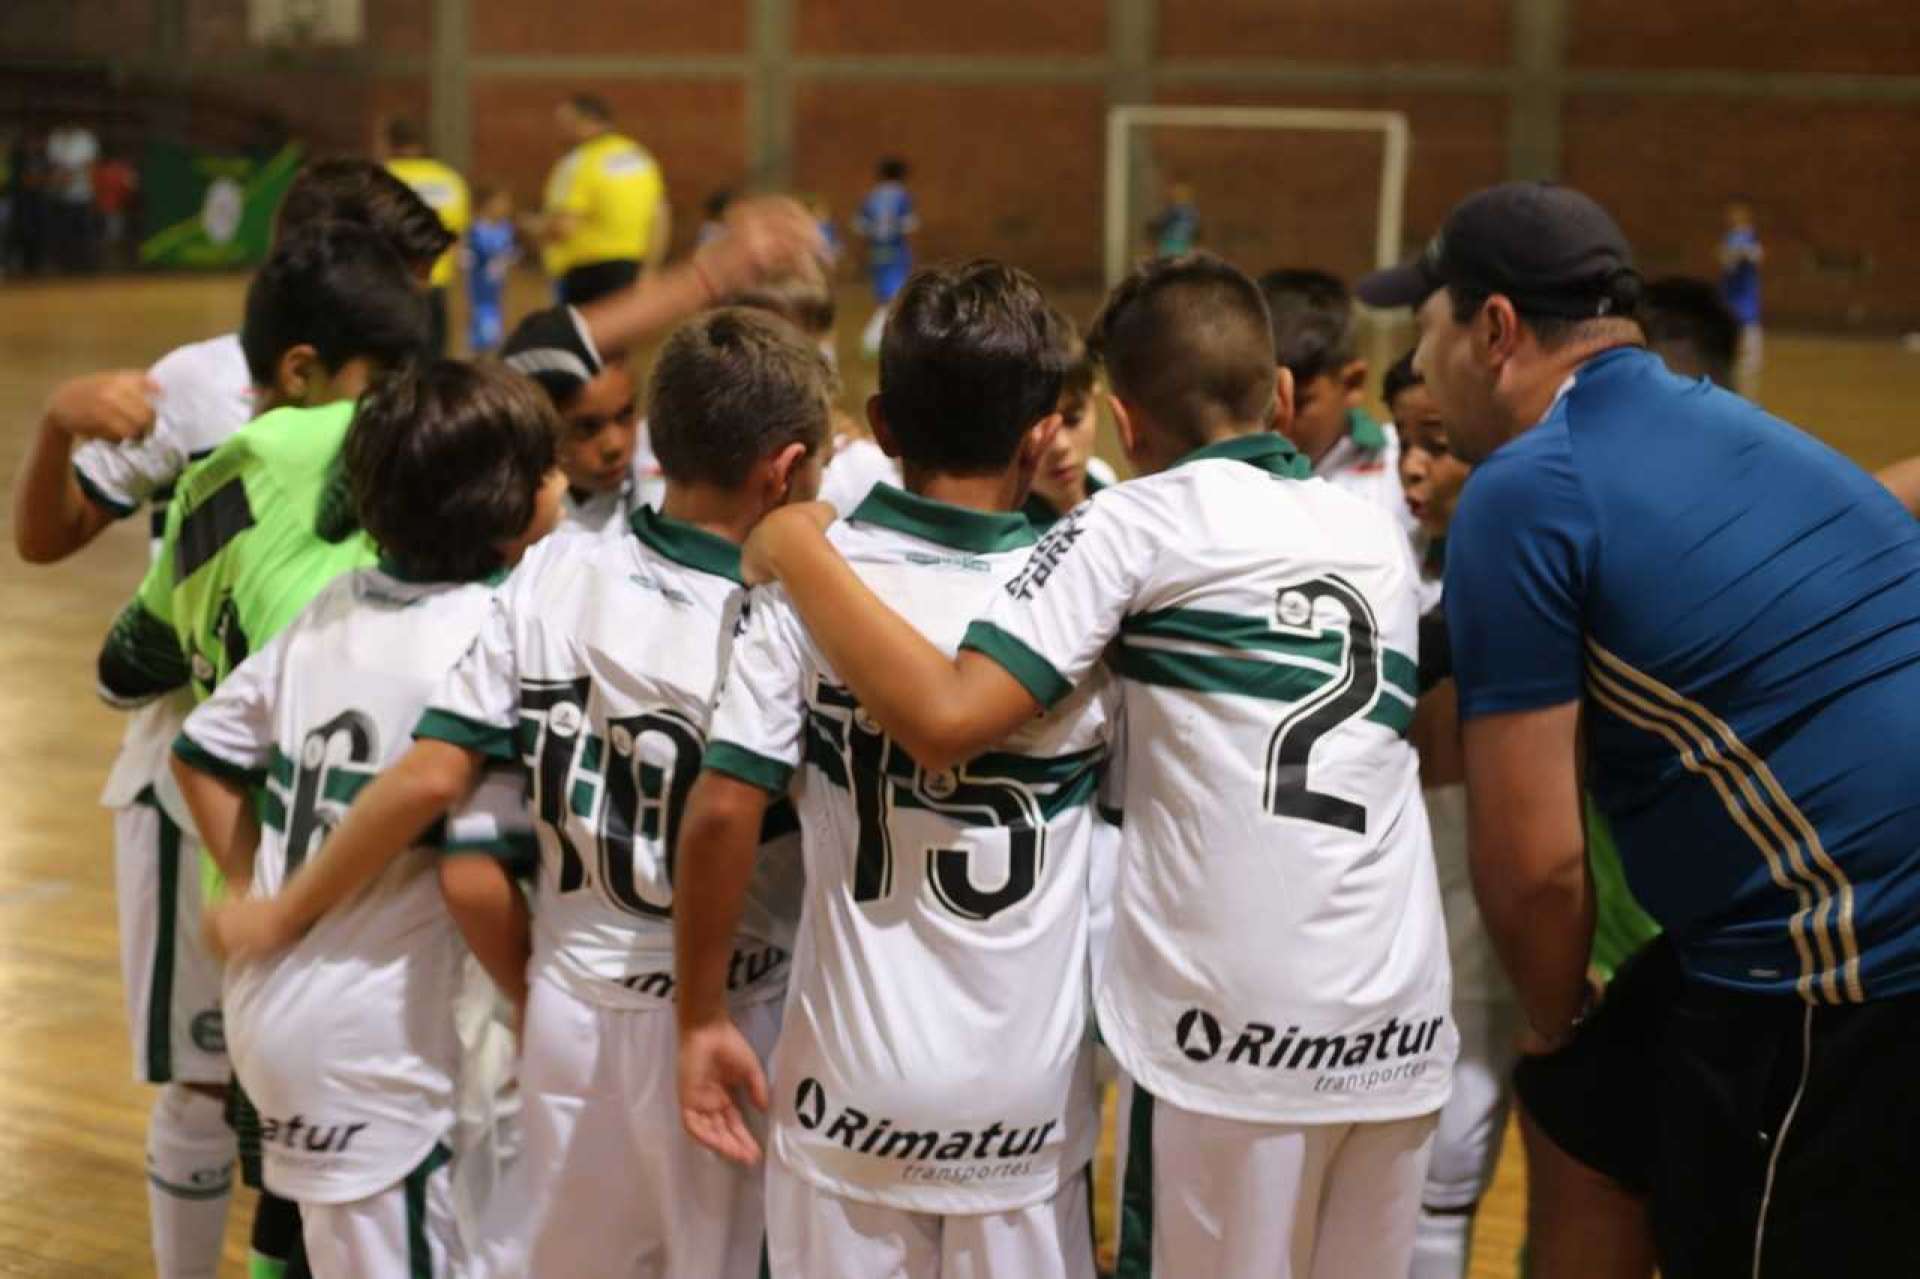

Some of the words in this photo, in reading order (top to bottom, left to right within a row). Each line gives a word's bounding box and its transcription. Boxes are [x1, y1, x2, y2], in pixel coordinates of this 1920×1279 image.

[1015, 527, 1085, 601] TORK
[1262, 573, 1379, 836] 2
[519, 676, 707, 924] 10
[815, 675, 1047, 921] 15
[1225, 1014, 1444, 1070] Rimatur
[260, 1112, 371, 1154] atur
[824, 1106, 1057, 1161] Rimatur
[900, 1160, 1032, 1182] transportes
